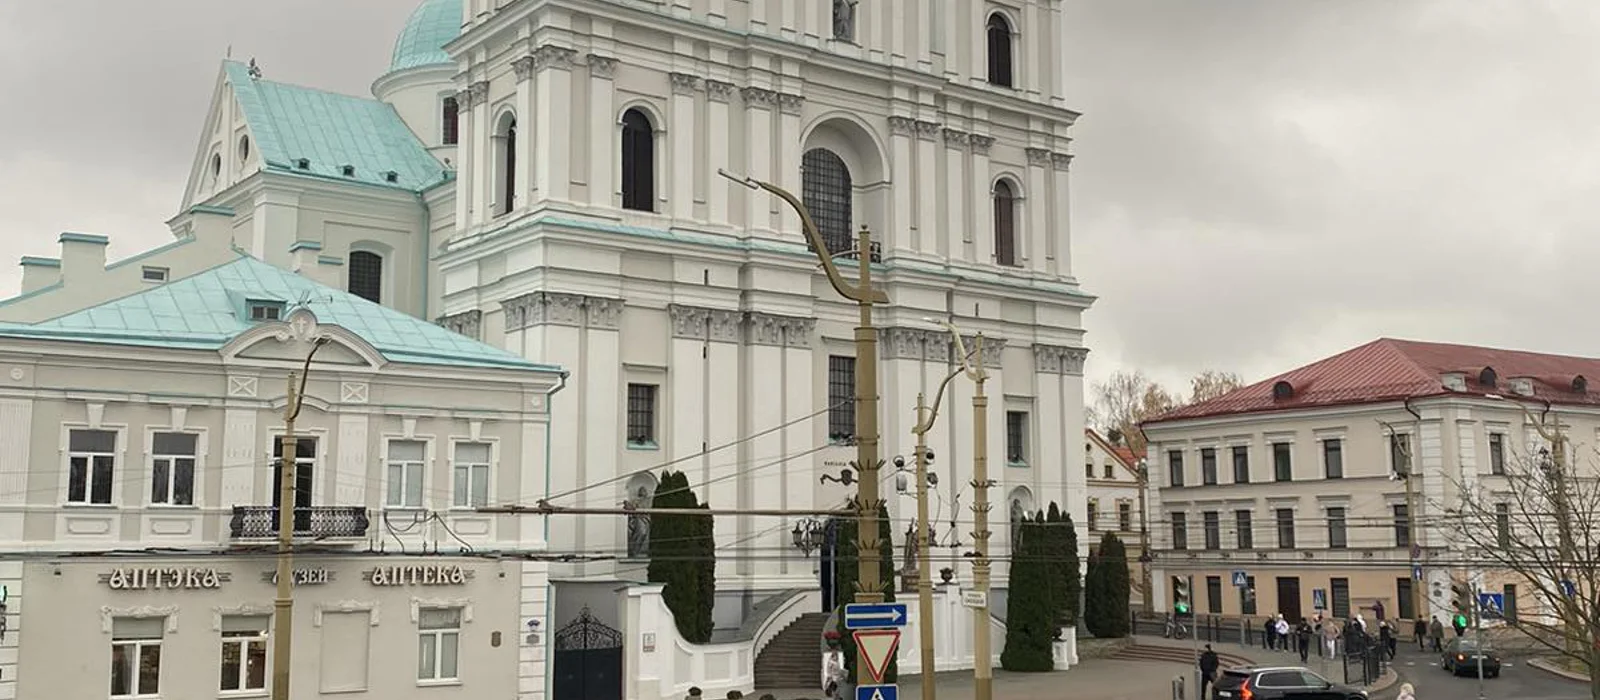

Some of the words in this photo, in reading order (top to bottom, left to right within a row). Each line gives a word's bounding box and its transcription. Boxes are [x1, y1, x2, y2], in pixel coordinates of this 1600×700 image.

[109, 568, 221, 588] АПТЭКА
[272, 567, 328, 588] УЗЕЙ
[372, 565, 466, 585] АПТЕКА
